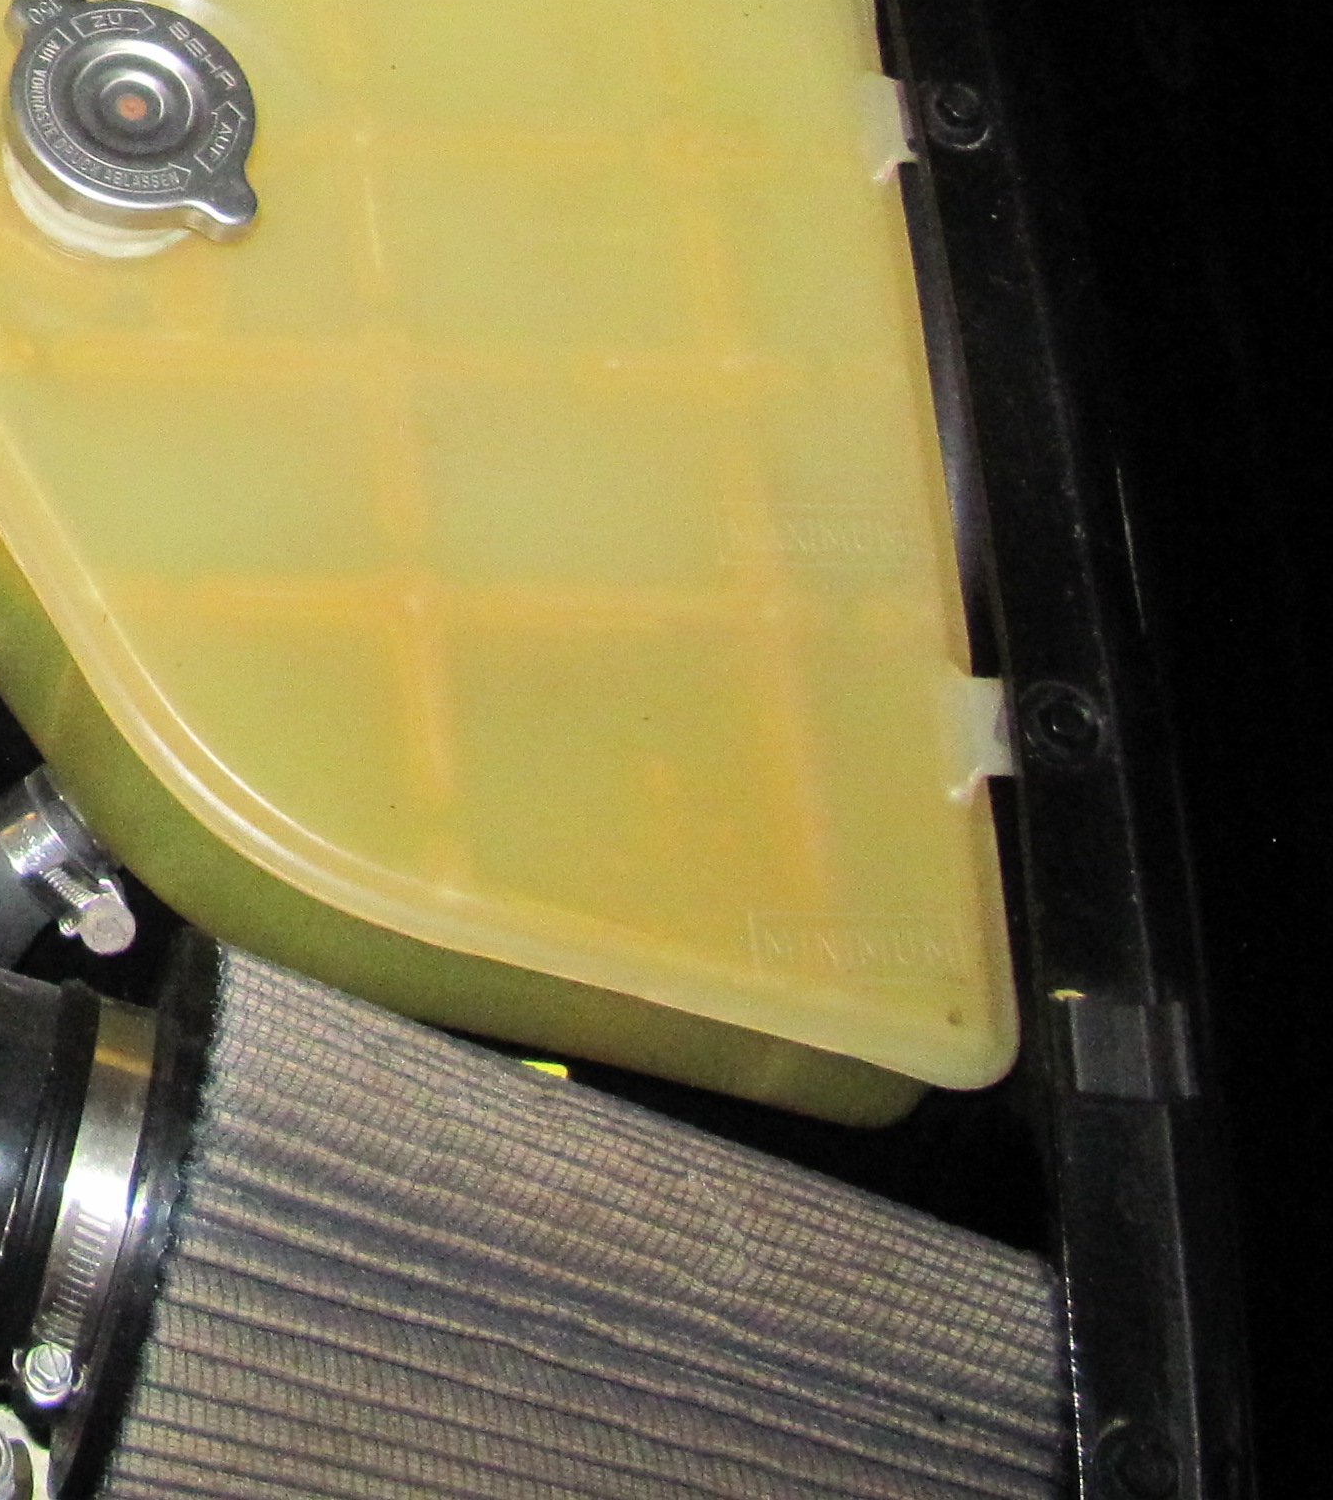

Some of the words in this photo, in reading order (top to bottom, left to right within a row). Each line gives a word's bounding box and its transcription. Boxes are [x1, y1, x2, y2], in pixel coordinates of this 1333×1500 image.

[90, 13, 123, 29] ZU
[167, 21, 238, 90] BEHR
[208, 121, 234, 161] AUF
[103, 171, 181, 189] ABLASSEN
